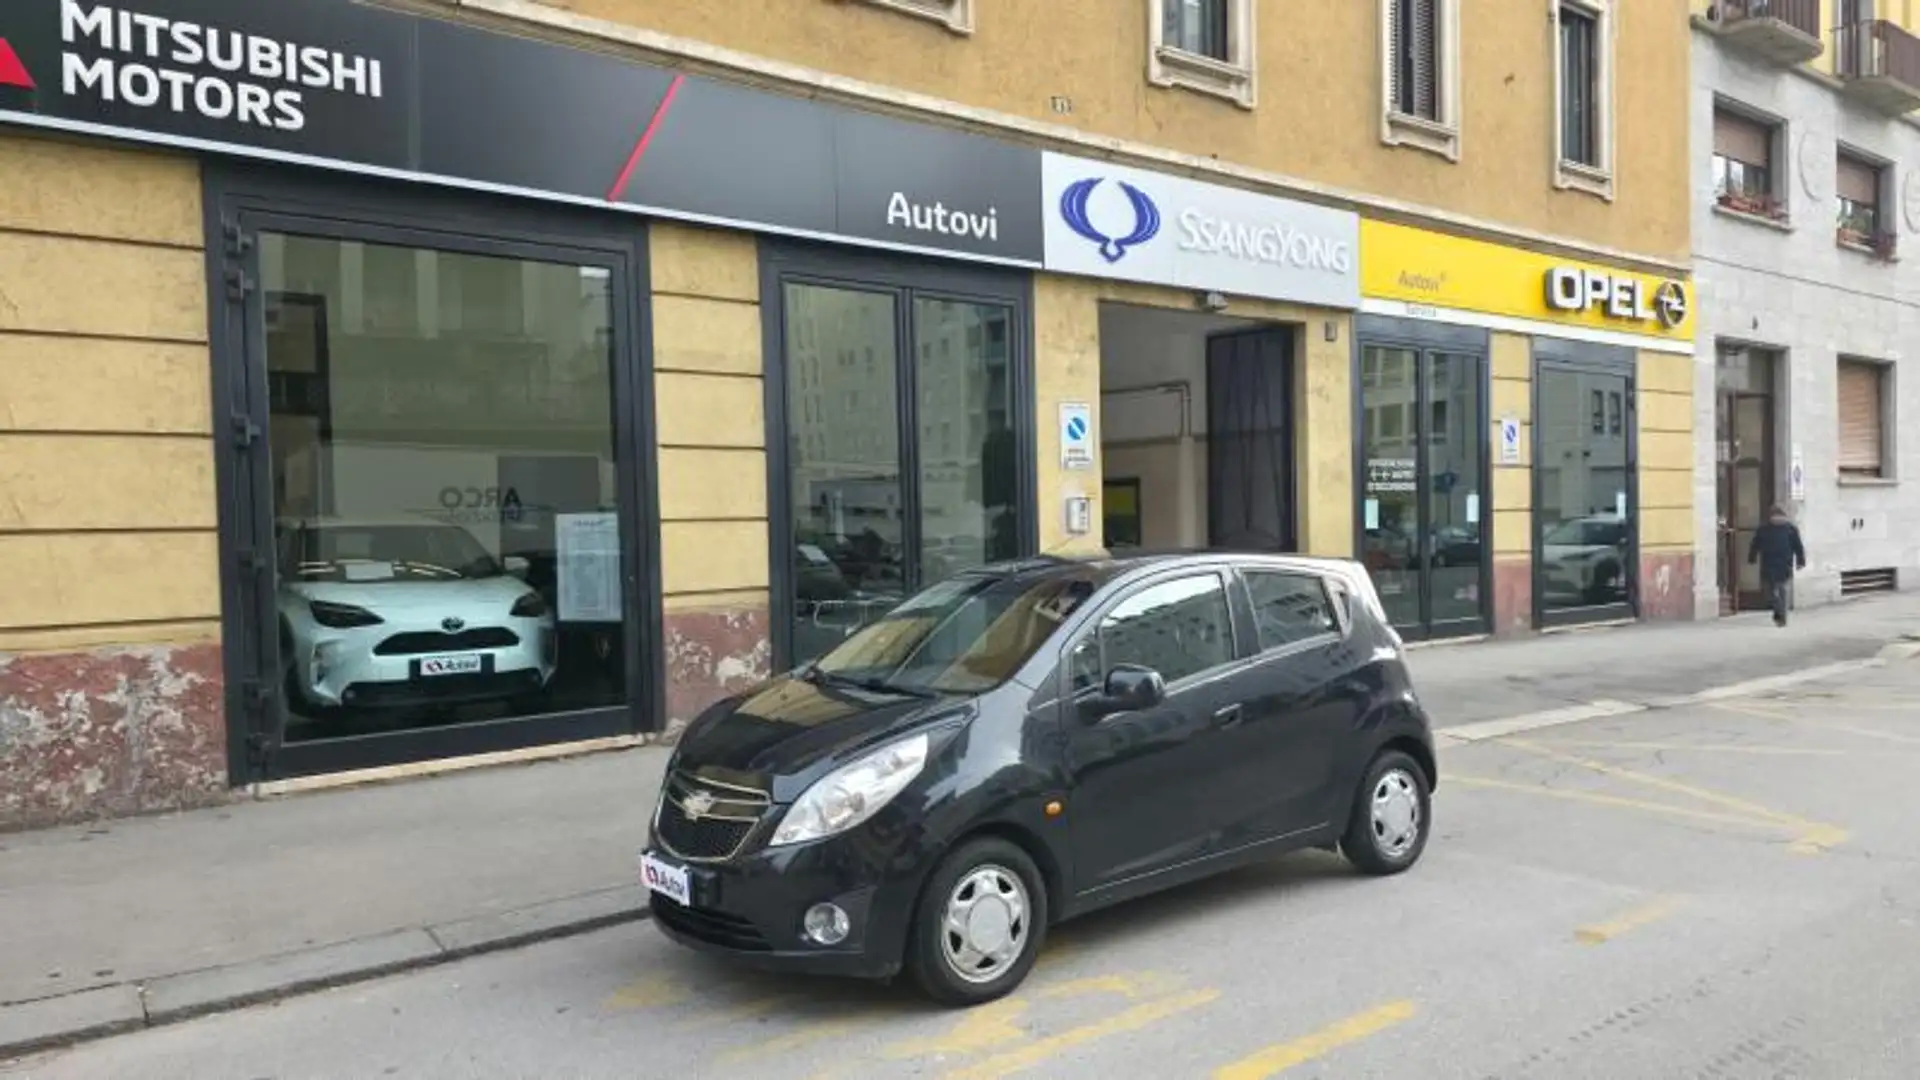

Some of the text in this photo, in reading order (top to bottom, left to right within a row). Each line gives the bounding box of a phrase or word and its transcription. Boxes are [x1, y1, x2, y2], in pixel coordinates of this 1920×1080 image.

[60, 0, 382, 97] MITSUBISHI
[62, 53, 304, 131] MOTORS
[887, 191, 998, 241] Autovi
[1545, 265, 1657, 318] OPEL
